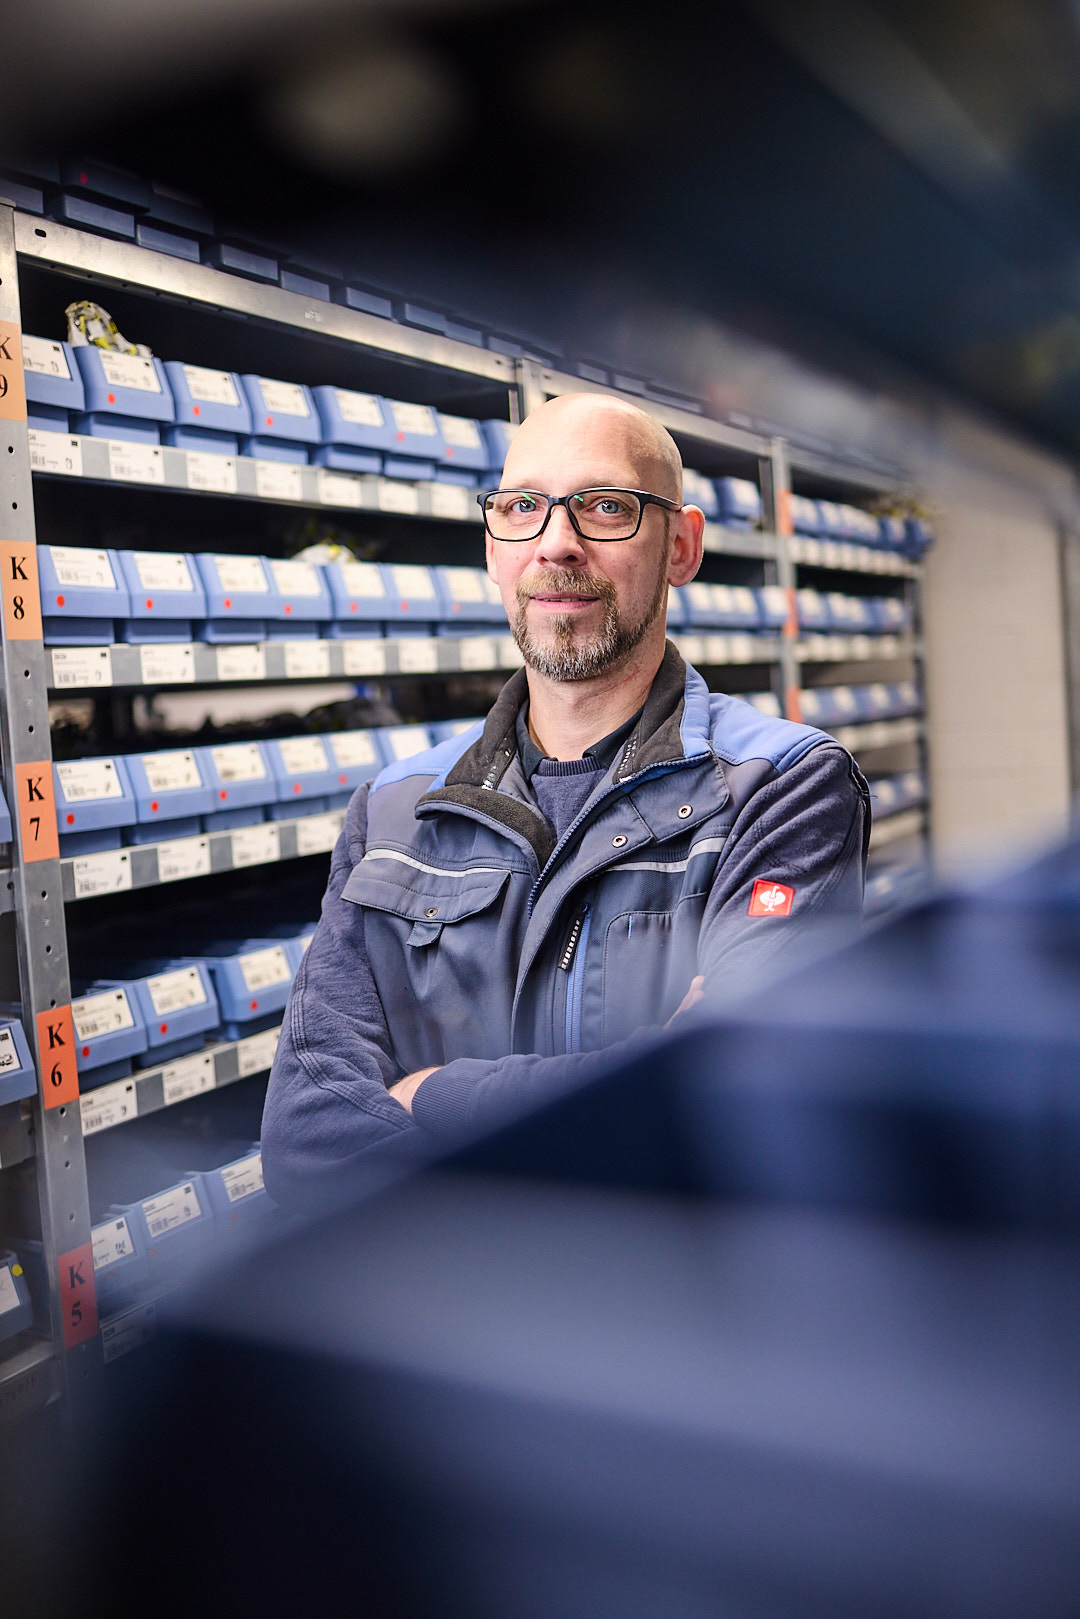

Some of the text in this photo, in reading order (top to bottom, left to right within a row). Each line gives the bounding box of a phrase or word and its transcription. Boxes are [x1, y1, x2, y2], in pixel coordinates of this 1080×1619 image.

[0, 334, 13, 361] K
[0, 374, 8, 398] 9
[10, 556, 28, 581] K
[13, 595, 25, 620] 8
[26, 777, 45, 802] K
[29, 817, 41, 841] 7
[47, 1022, 66, 1050] K
[50, 1062, 62, 1088] 6
[67, 1261, 86, 1290] K
[71, 1301, 82, 1327] 5
